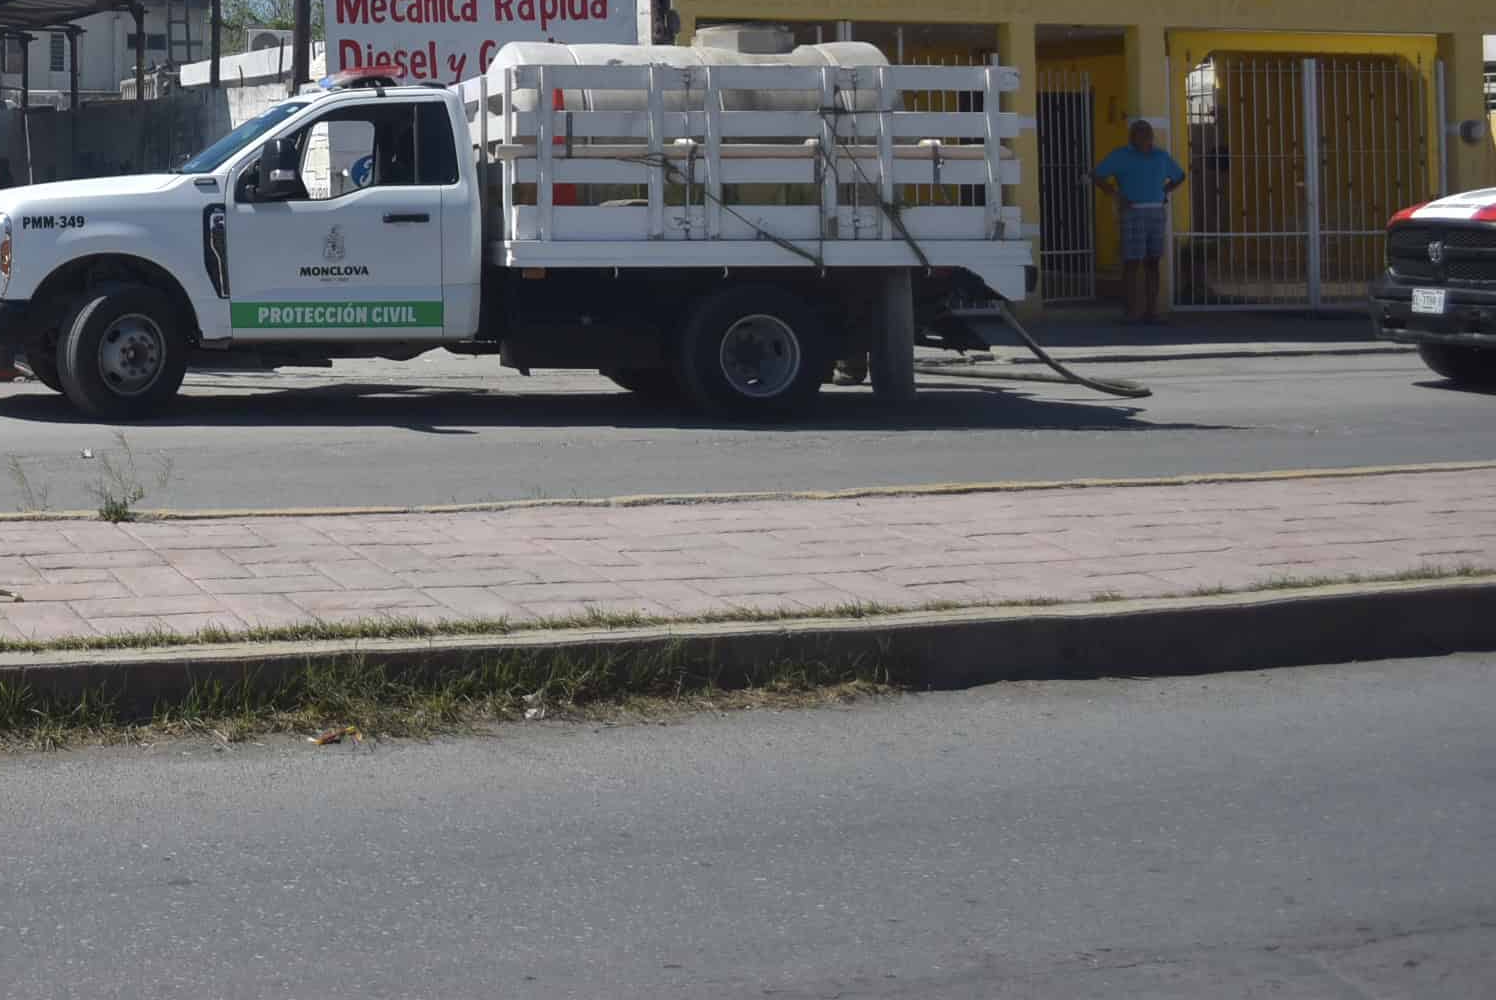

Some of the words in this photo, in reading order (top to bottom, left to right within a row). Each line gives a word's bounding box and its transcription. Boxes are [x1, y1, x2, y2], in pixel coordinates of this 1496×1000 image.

[339, 39, 438, 80] Diesel
[448, 52, 466, 84] y
[23, 216, 85, 229] PMM-349
[299, 266, 368, 277] MONCLOVA
[258, 303, 367, 323] PROTECCIÓN
[372, 307, 416, 323] CIVIL
